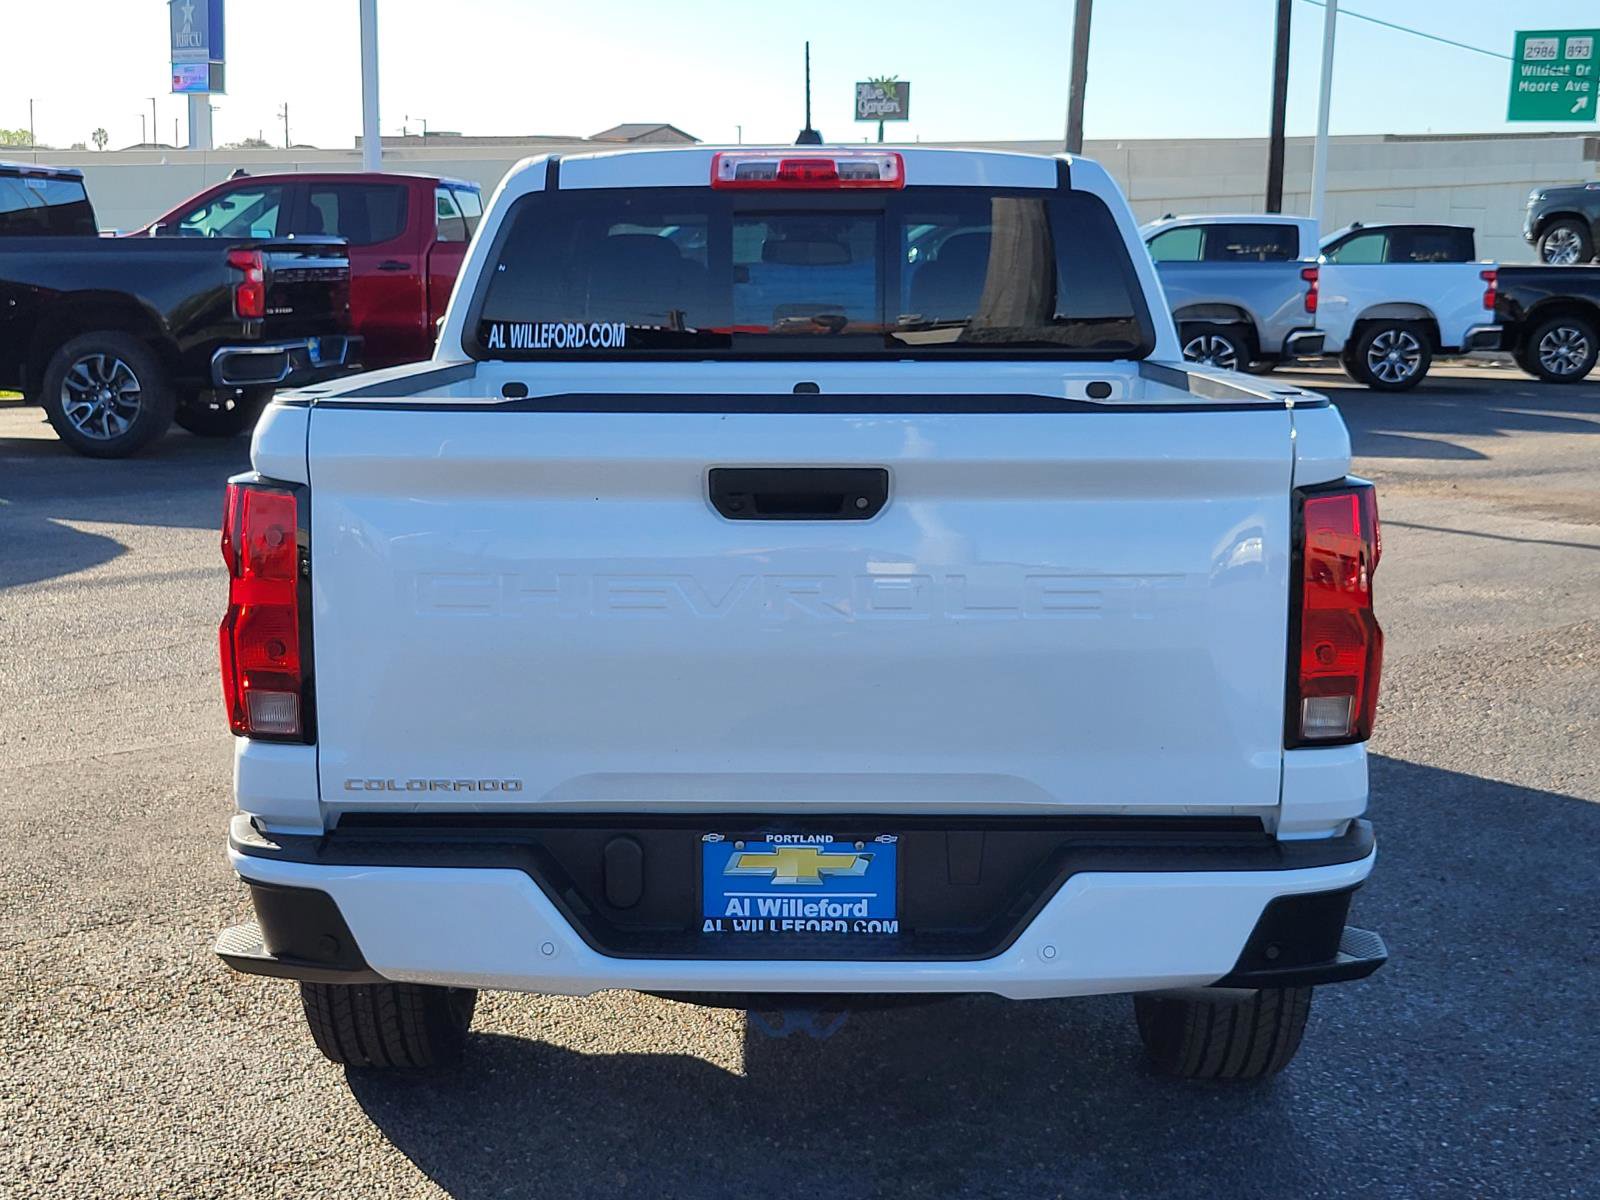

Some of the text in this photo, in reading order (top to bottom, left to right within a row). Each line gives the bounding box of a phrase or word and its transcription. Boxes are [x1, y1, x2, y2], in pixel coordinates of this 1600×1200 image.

[1525, 46, 1556, 58] 2986
[1567, 45, 1590, 57] 893
[1575, 64, 1592, 76] Dr
[1518, 80, 1590, 92] Moore Ave
[488, 322, 626, 348] AL WILLEFORD.COM
[414, 573, 1186, 619] CHEVROLET
[344, 778, 523, 792] COLORADO
[766, 834, 834, 844] PORTLAND
[725, 898, 868, 917] Al Willeford
